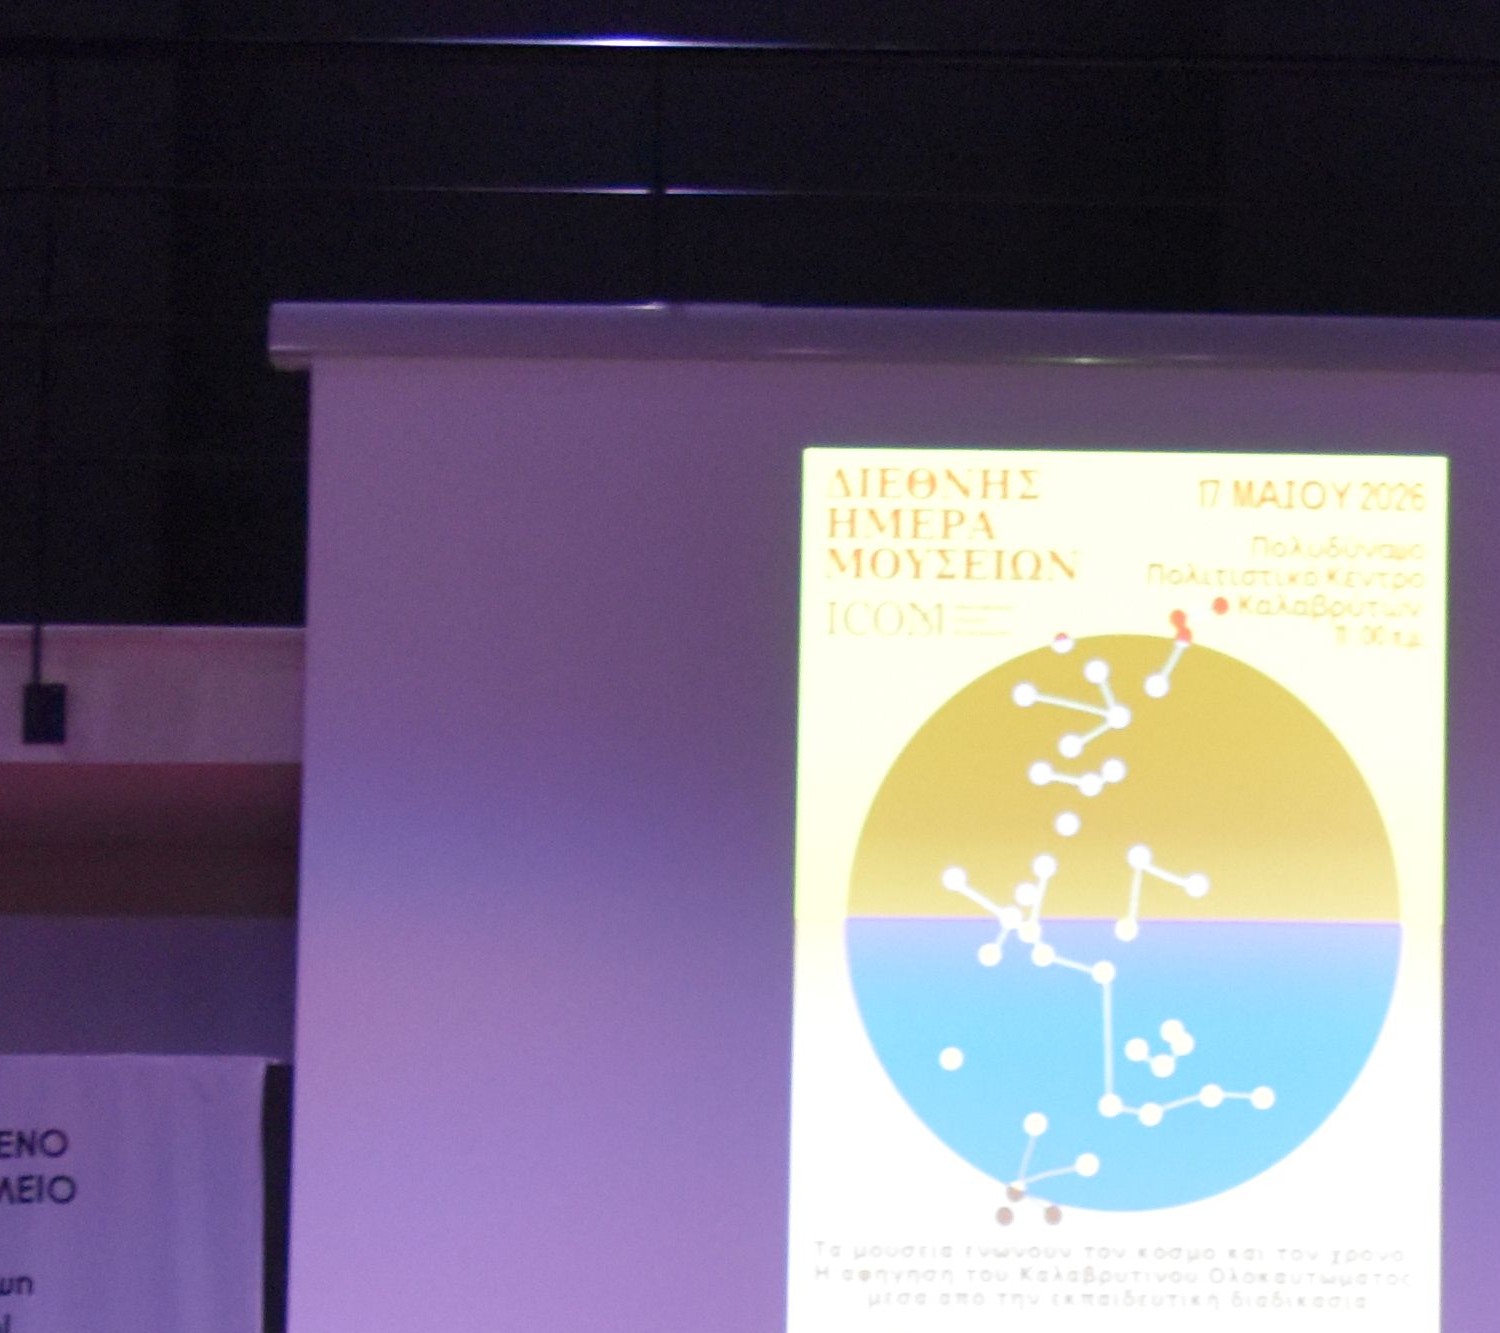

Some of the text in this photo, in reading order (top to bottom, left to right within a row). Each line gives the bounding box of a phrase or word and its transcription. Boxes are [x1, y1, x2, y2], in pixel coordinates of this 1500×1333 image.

[829, 467, 1040, 500] ΔΙΕΘΝΗΣ
[1198, 479, 1221, 508] 17
[827, 507, 997, 541] ΗΜΕΡΑ
[826, 548, 1078, 582] ΜΟΥΣΕΙΩΝ
[1083, 1245, 1126, 1260] τον
[1276, 1247, 1318, 1262] τον
